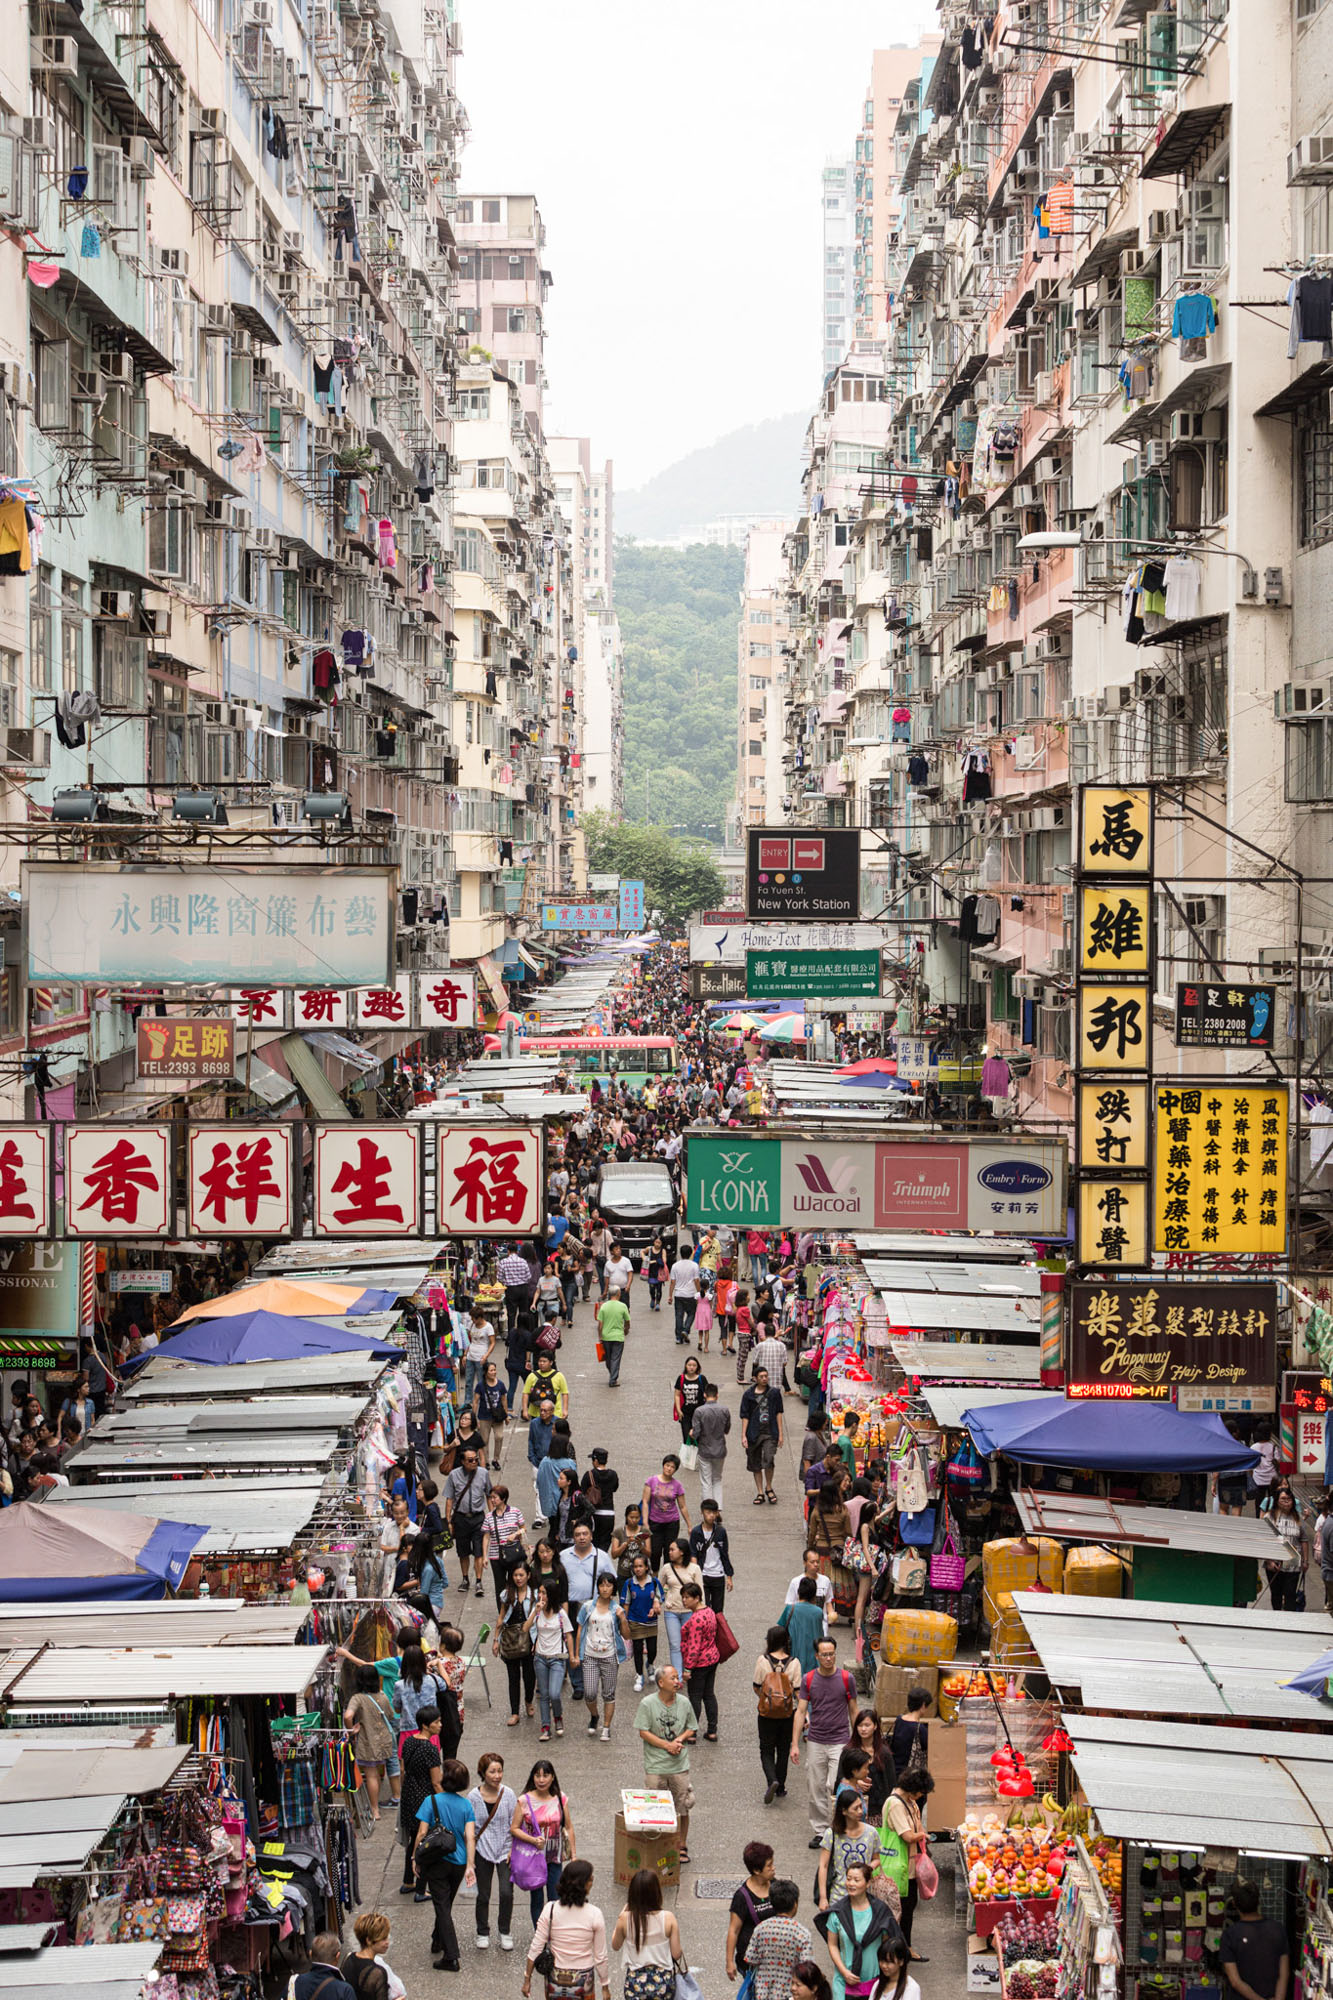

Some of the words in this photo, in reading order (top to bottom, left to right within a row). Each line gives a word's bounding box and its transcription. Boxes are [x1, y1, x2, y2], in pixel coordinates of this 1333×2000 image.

[758, 887, 769, 895] Fa
[771, 887, 794, 895] Yuen
[796, 887, 807, 895] St.
[758, 899, 782, 910] New
[785, 899, 809, 910] York
[812, 899, 851, 910] Station
[1226, 1019, 1247, 1031] 2008
[171, 1026, 228, 1058] 足跡
[202, 1062, 231, 1075] 8698
[985, 1174, 1017, 1187] Embry
[1021, 1174, 1047, 1185] Form
[701, 1180, 769, 1212] LEONA
[893, 1180, 950, 1199] Triumph
[794, 1195, 861, 1213] Wacoal
[991, 1202, 1039, 1214] 安莉芳
[5, 1357, 30, 1368] 2393
[31, 1357, 56, 1368] 8698
[1170, 1364, 1202, 1384] Hair
[1205, 1363, 1247, 1384] Design
